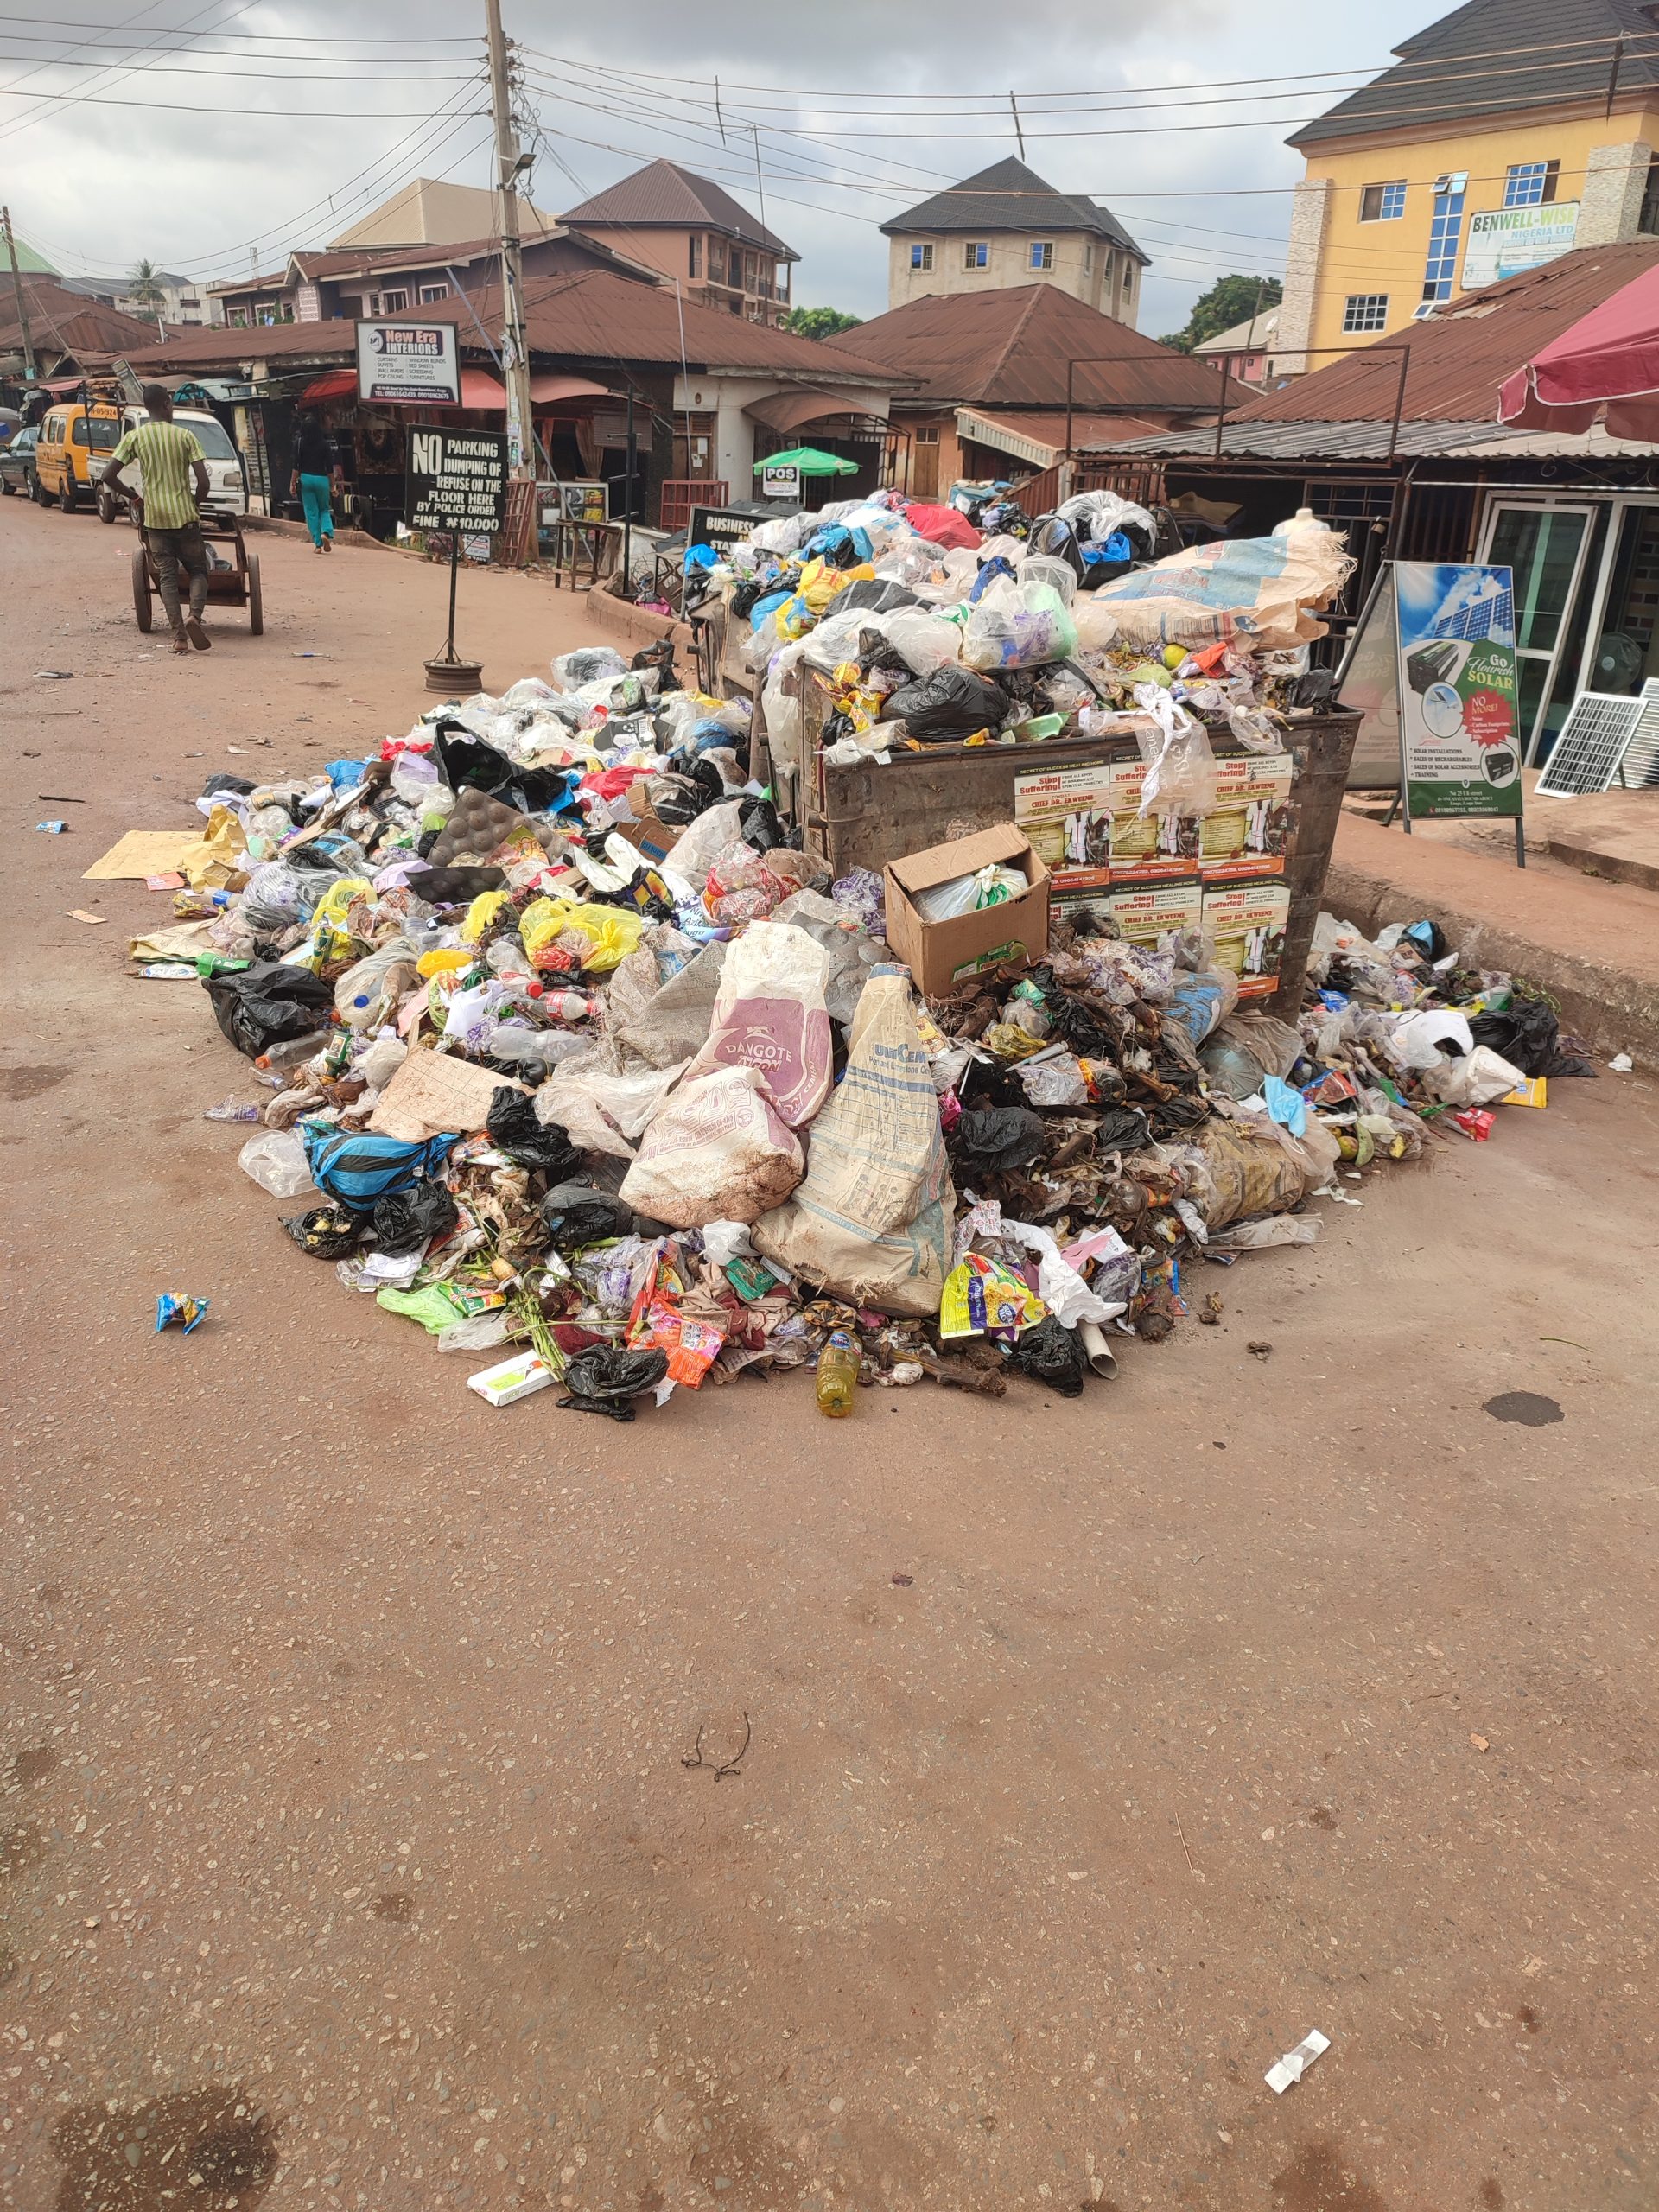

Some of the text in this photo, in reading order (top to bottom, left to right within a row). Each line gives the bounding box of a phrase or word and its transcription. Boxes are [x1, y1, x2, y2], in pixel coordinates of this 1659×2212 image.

[1473, 207, 1576, 232] BENWELL-WISE
[1511, 226, 1573, 238] NIGERIA LTD
[385, 330, 437, 344] New Era
[387, 343, 438, 354] INTERIORS
[413, 433, 442, 475] NO
[448, 439, 498, 458] PARKING
[444, 458, 501, 476] DUMPING OF
[767, 468, 795, 480] POS
[436, 475, 501, 493] REFUSE ON THE
[429, 491, 494, 505] FLOOR HERE
[416, 502, 495, 515] BY POLICE ORDER
[412, 515, 440, 527] FINE
[706, 516, 755, 534] BUSINESS
[1467, 657, 1514, 676] Flourish
[1490, 654, 1508, 667] Go
[1467, 671, 1513, 690] SOLAR
[1472, 697, 1486, 706] NO
[1472, 703, 1498, 714] MORE!
[726, 1042, 792, 1063] DANGOTE
